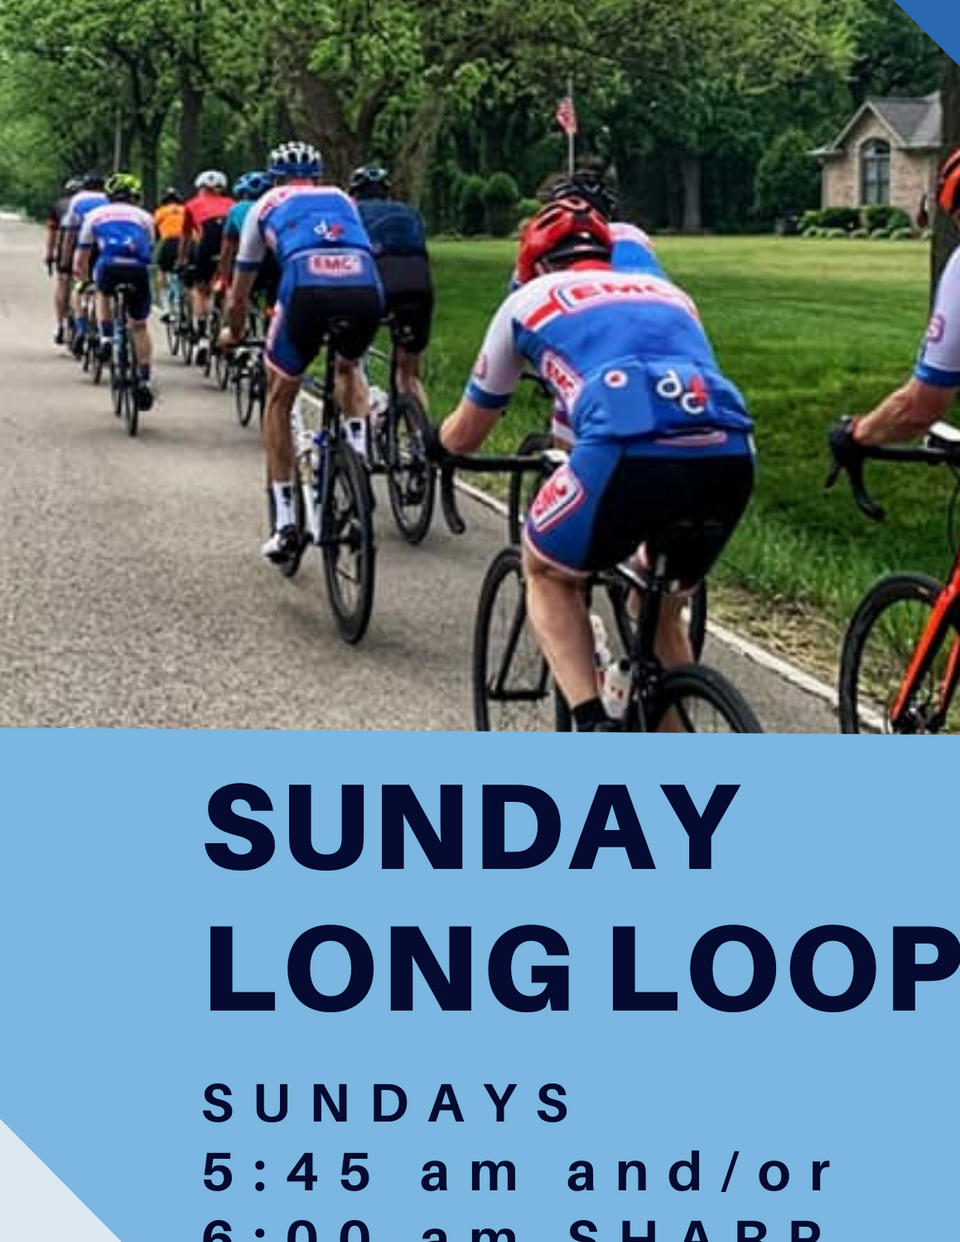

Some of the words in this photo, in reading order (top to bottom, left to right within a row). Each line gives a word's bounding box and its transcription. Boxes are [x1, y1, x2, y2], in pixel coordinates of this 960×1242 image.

[205, 783, 740, 871] SUNDAY
[210, 925, 569, 1012] LONG
[613, 925, 960, 1012] LOOP
[203, 1083, 567, 1122] SUNDAYS
[204, 1153, 369, 1191] 5:45
[421, 1161, 515, 1191] am
[568, 1150, 830, 1192] and/or
